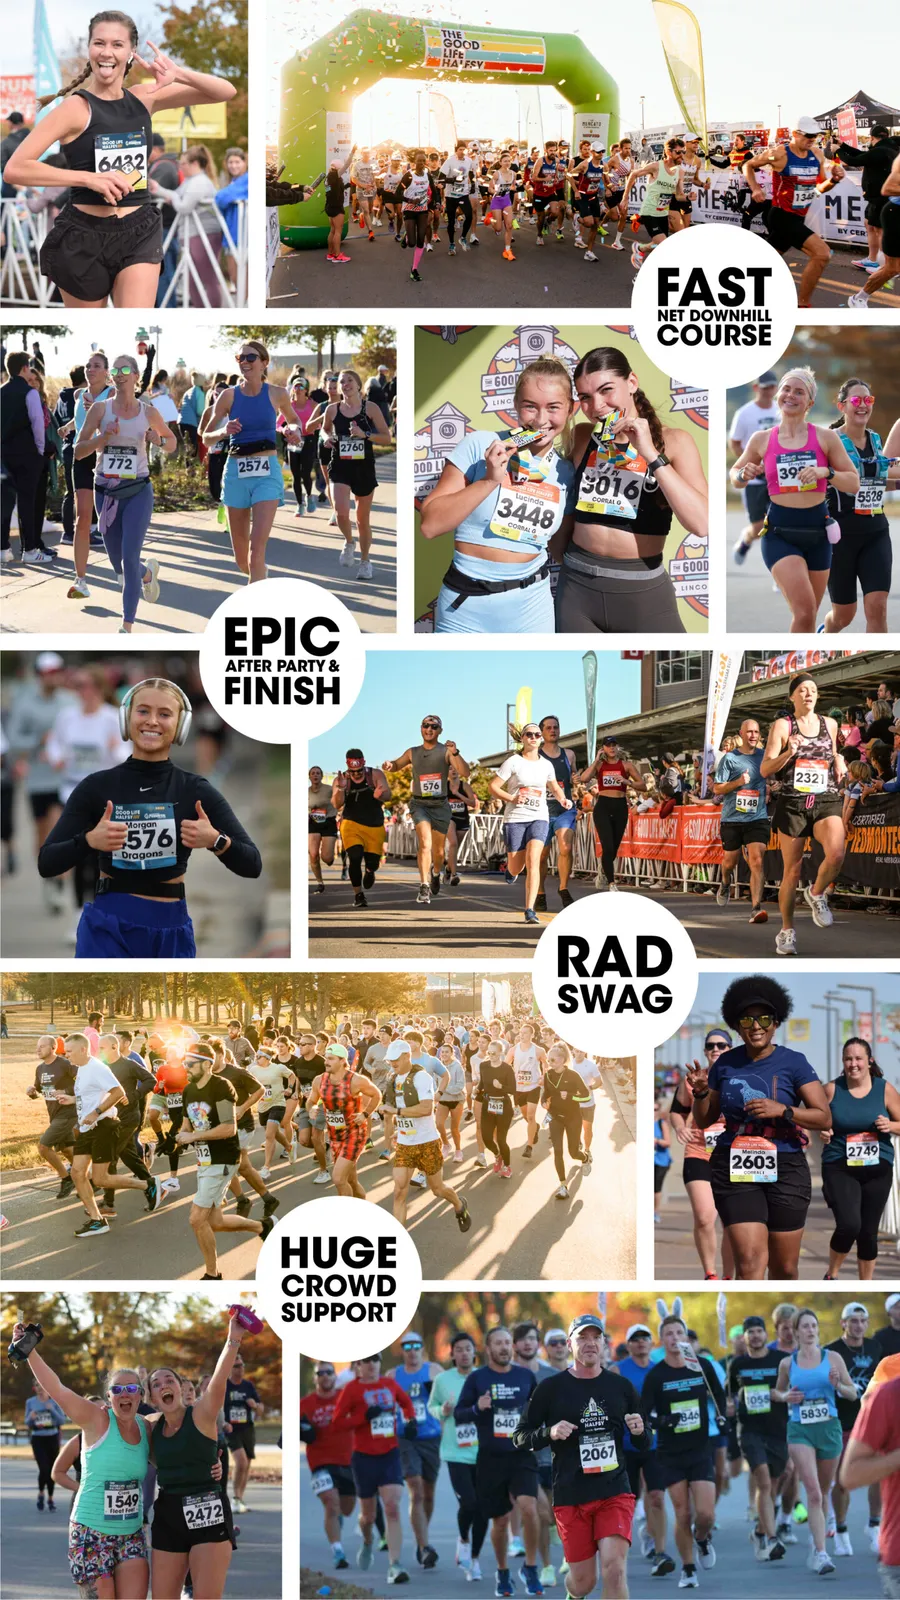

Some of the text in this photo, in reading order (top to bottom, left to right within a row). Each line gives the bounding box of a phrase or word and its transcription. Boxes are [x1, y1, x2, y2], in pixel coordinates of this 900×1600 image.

[441, 29, 462, 39] THE
[443, 38, 480, 50] GOOD
[443, 49, 464, 59] LIFE
[340, 443, 364, 453] 2760
[108, 458, 133, 470] 772
[239, 460, 270, 472] 2574
[515, 493, 545, 506] Lucinda
[857, 490, 884, 503] 5528
[497, 497, 556, 530] 3448
[682, 560, 709, 573] GOOD
[795, 772, 825, 785] 2321
[423, 781, 440, 791] 576
[736, 798, 758, 807] 5148
[852, 813, 886, 826] CERTIFIED
[122, 828, 173, 850] 576
[121, 850, 163, 860] Dragons
[848, 1145, 878, 1157] 2749
[731, 1154, 776, 1170] 2603
[800, 1407, 828, 1419] 5839
[581, 1445, 615, 1462] 2067
[106, 1493, 139, 1509] 1549
[185, 1504, 223, 1523] 2472
